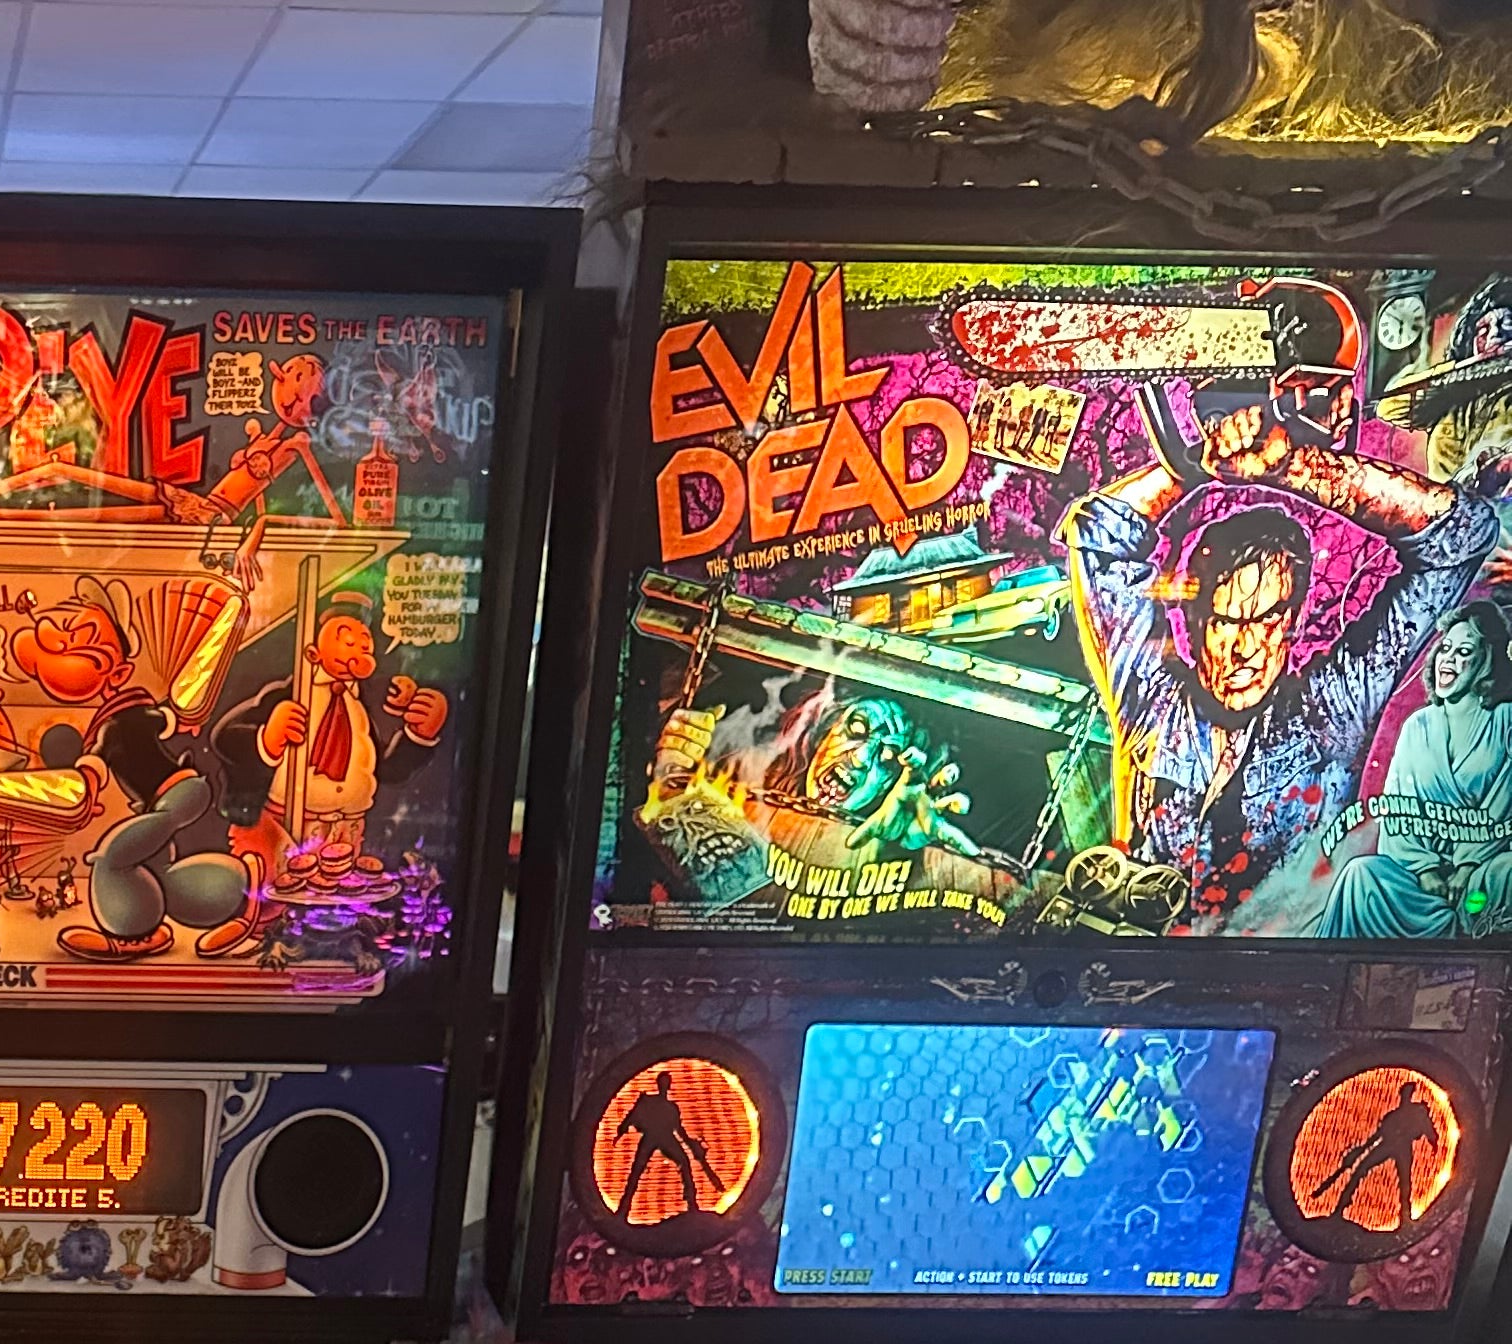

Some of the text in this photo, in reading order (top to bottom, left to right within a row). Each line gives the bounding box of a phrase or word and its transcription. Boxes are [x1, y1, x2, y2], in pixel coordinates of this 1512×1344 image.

[212, 309, 487, 346] SAVES THE EARTH
[650, 259, 890, 444] EVIL
[238, 367, 251, 377] BE
[358, 487, 392, 498] OLIVE
[656, 396, 970, 564] DEAD
[706, 502, 992, 578] THE ULTIMATE EXPERIENCE IN GRUELING HORROR
[387, 589, 409, 601] YOU
[401, 602, 422, 613] FOR
[1321, 800, 1365, 857] WE'RE
[1368, 795, 1420, 818] GONNA
[1424, 801, 1454, 823] GET
[1384, 816, 1490, 842] WE'RE GONNA
[766, 844, 912, 898] YOU WILL DIE!
[788, 893, 816, 918] ONE
[817, 896, 838, 919] BY
[841, 896, 872, 918] ONE
[875, 895, 900, 913] WE
[903, 889, 937, 909] WILL
[942, 888, 973, 909] TAKE
[976, 895, 1007, 928] YOU!
[783, 1269, 872, 1285] PRESS START
[914, 1271, 1088, 1285] ACTION START TO USE TOKENS
[1146, 1272, 1220, 1288] FREE PLAY
